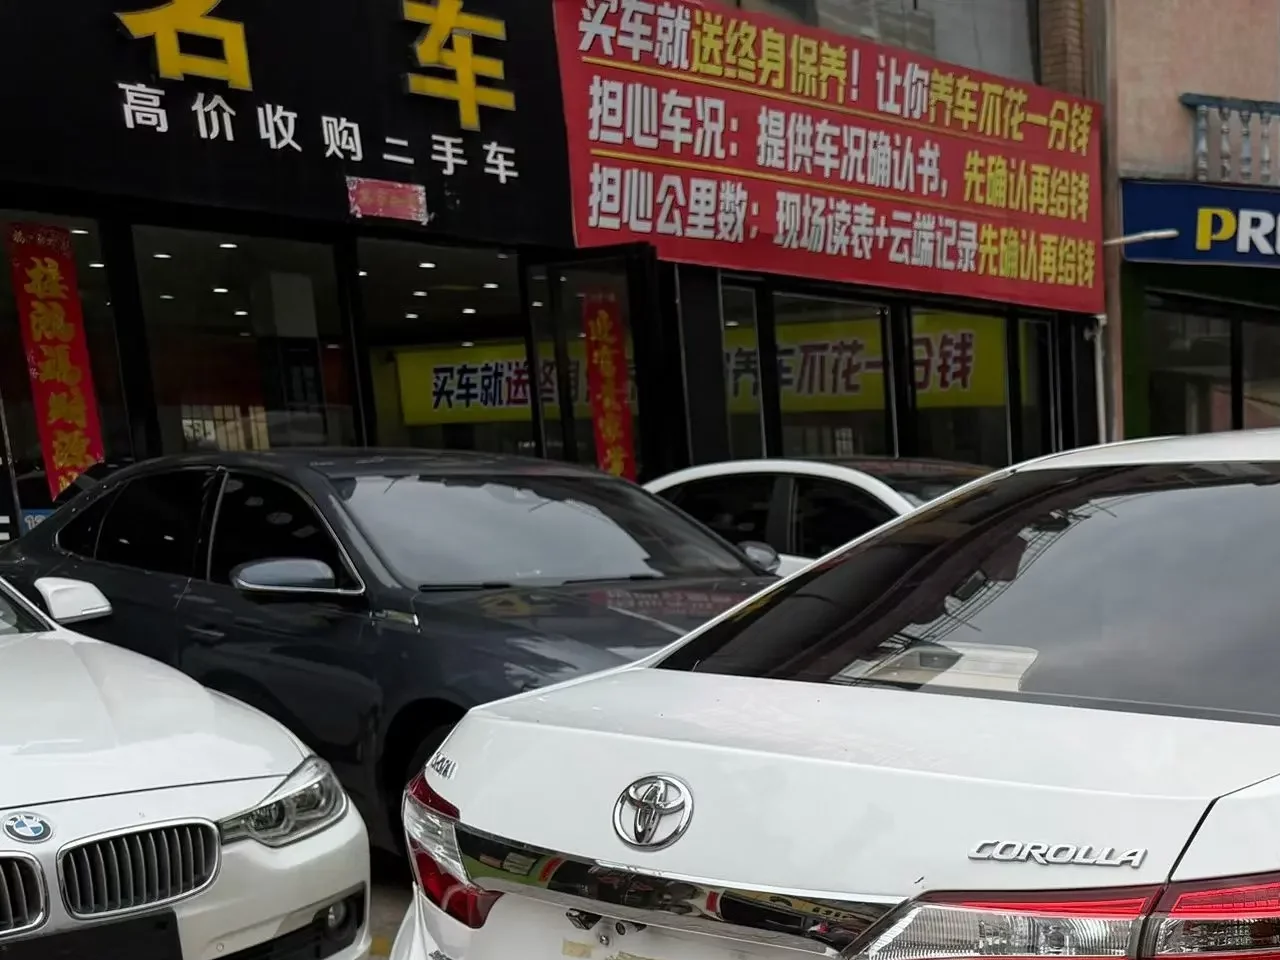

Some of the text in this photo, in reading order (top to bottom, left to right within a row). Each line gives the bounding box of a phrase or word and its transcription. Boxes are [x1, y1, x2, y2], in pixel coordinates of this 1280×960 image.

[118, 82, 519, 184] 高价收购二手车
[967, 839, 1148, 869] COROLLA
